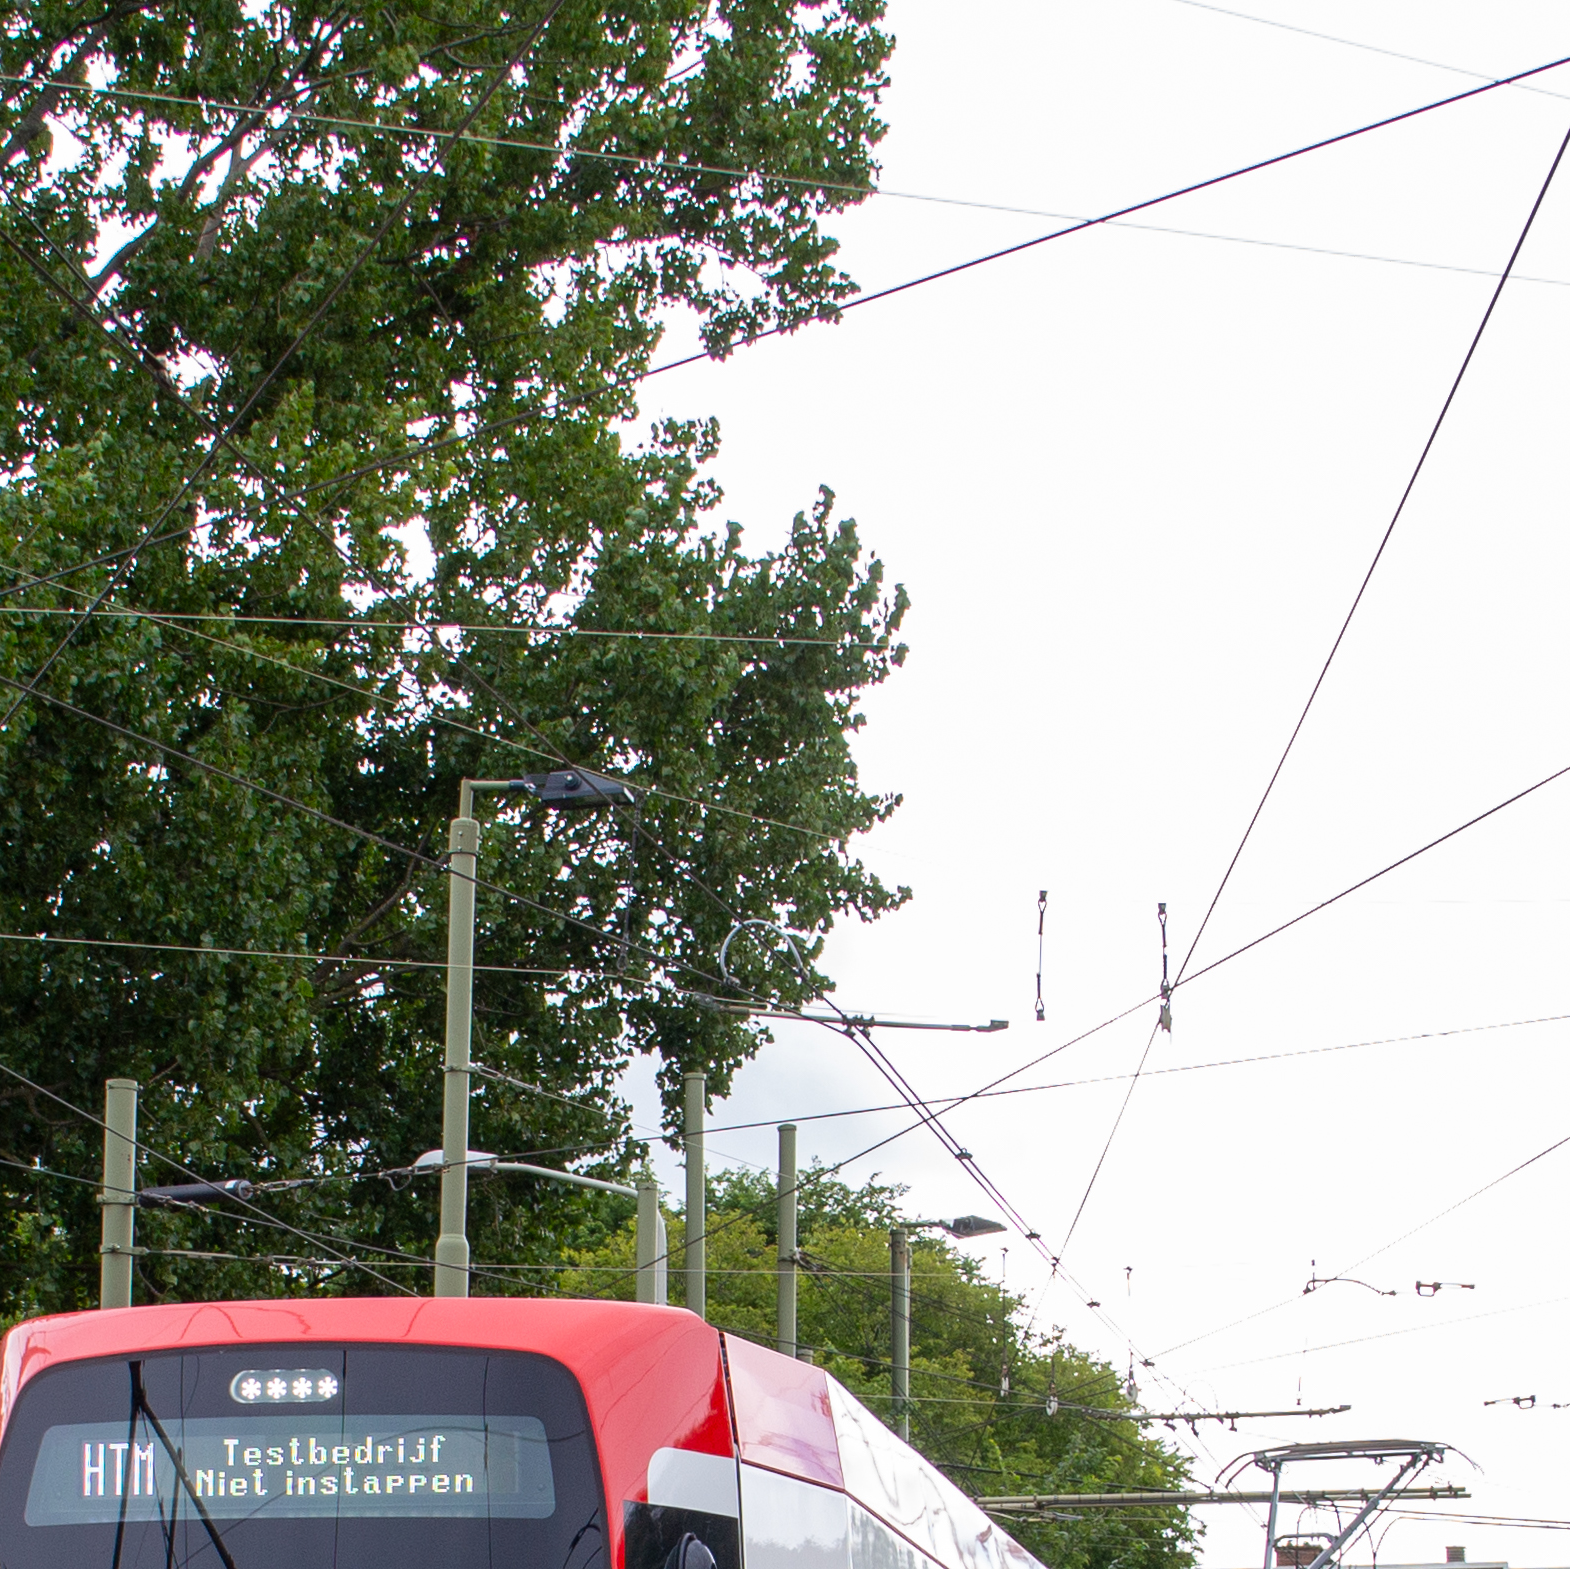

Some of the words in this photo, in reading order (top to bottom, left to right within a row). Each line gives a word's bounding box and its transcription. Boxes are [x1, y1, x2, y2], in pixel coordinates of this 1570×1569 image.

[223, 1435, 446, 1467] Testbedrijf
[83, 1442, 154, 1496] HTM
[196, 1468, 268, 1496] Niet
[285, 1466, 474, 1495] instappen
